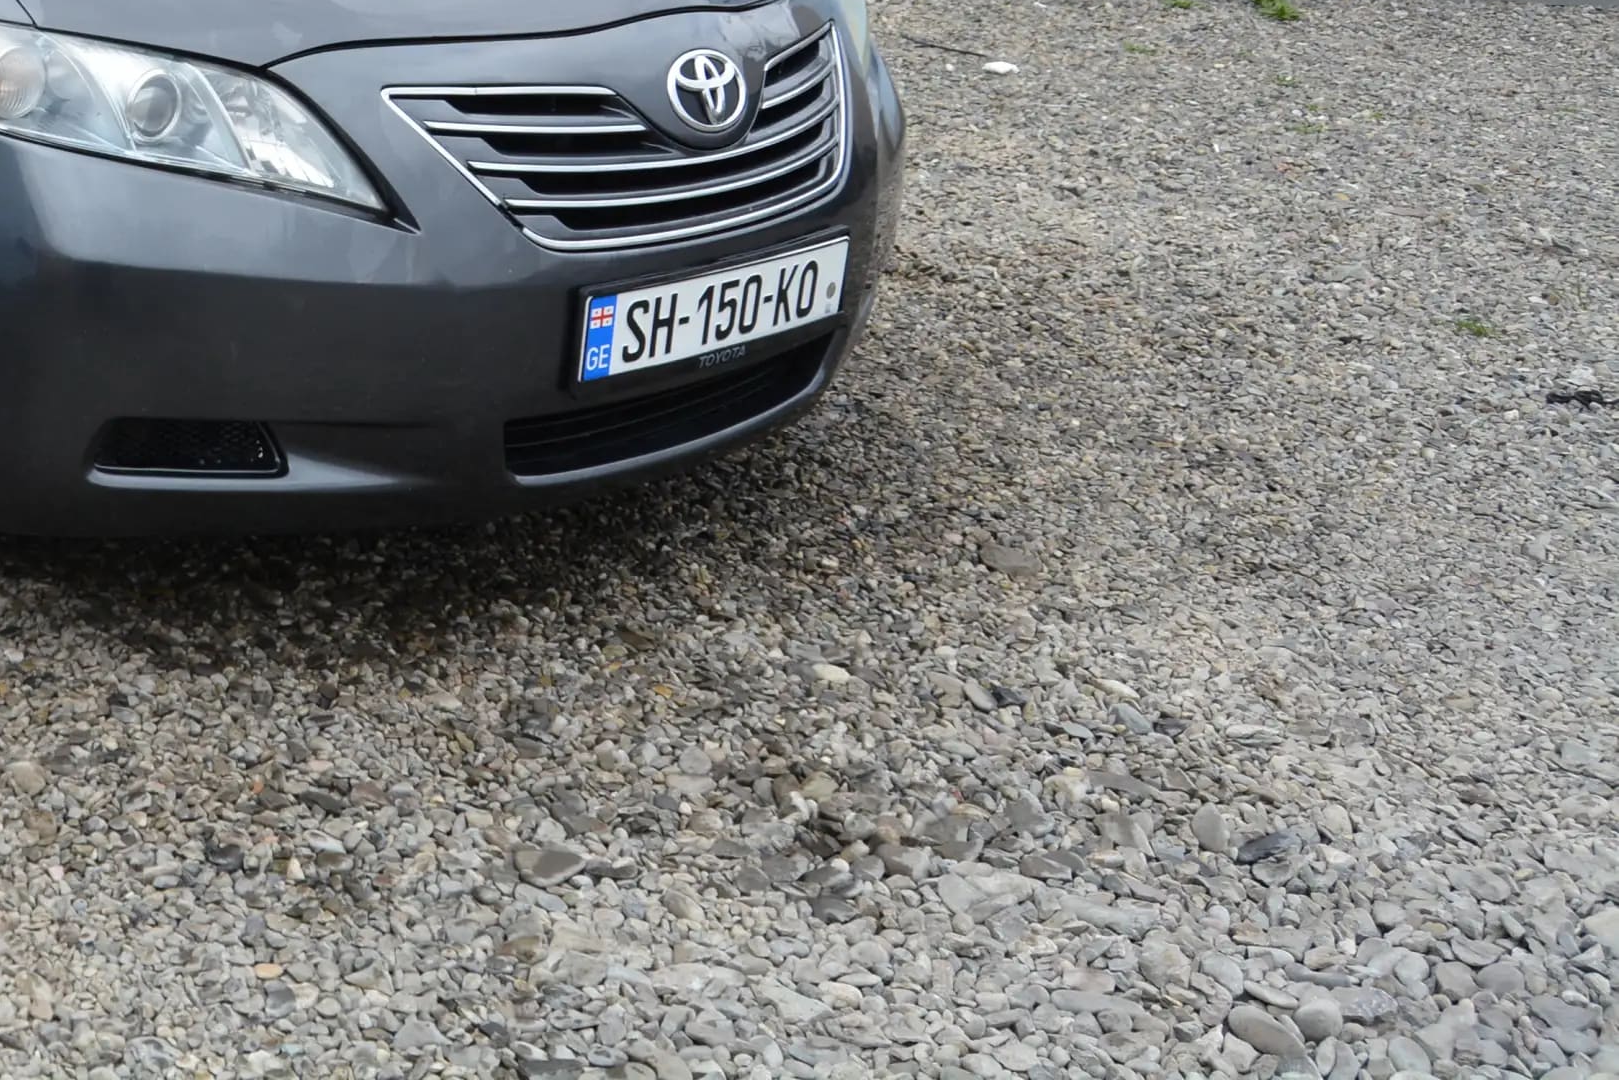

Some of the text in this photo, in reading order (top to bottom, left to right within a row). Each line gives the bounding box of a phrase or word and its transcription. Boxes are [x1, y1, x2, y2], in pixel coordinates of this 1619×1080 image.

[621, 259, 819, 364] SH-150-KO
[586, 343, 611, 371] GE
[698, 344, 746, 369] TOYOTA
